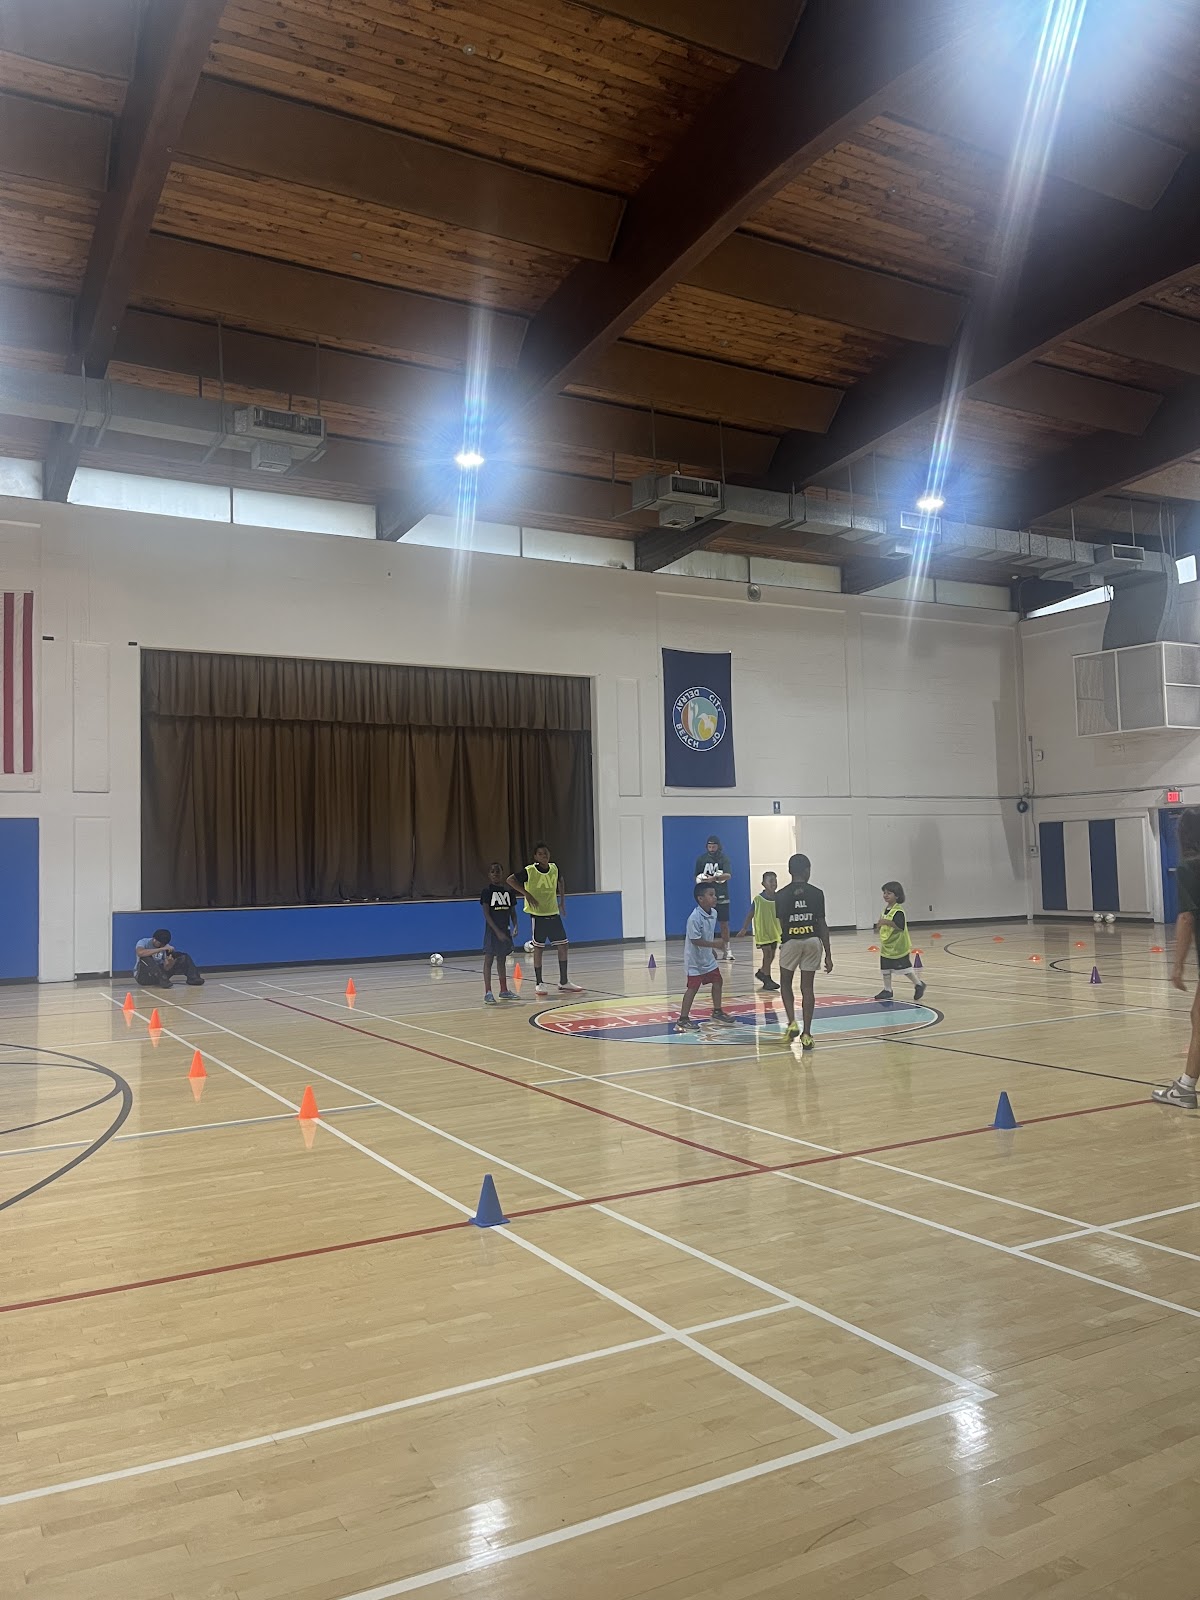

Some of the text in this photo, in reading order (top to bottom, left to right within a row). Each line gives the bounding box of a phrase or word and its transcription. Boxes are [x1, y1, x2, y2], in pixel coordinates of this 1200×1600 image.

[675, 689, 700, 748] DELRAY BEACH
[789, 913, 813, 922] ABOUT
[789, 926, 814, 935] FOOTY
